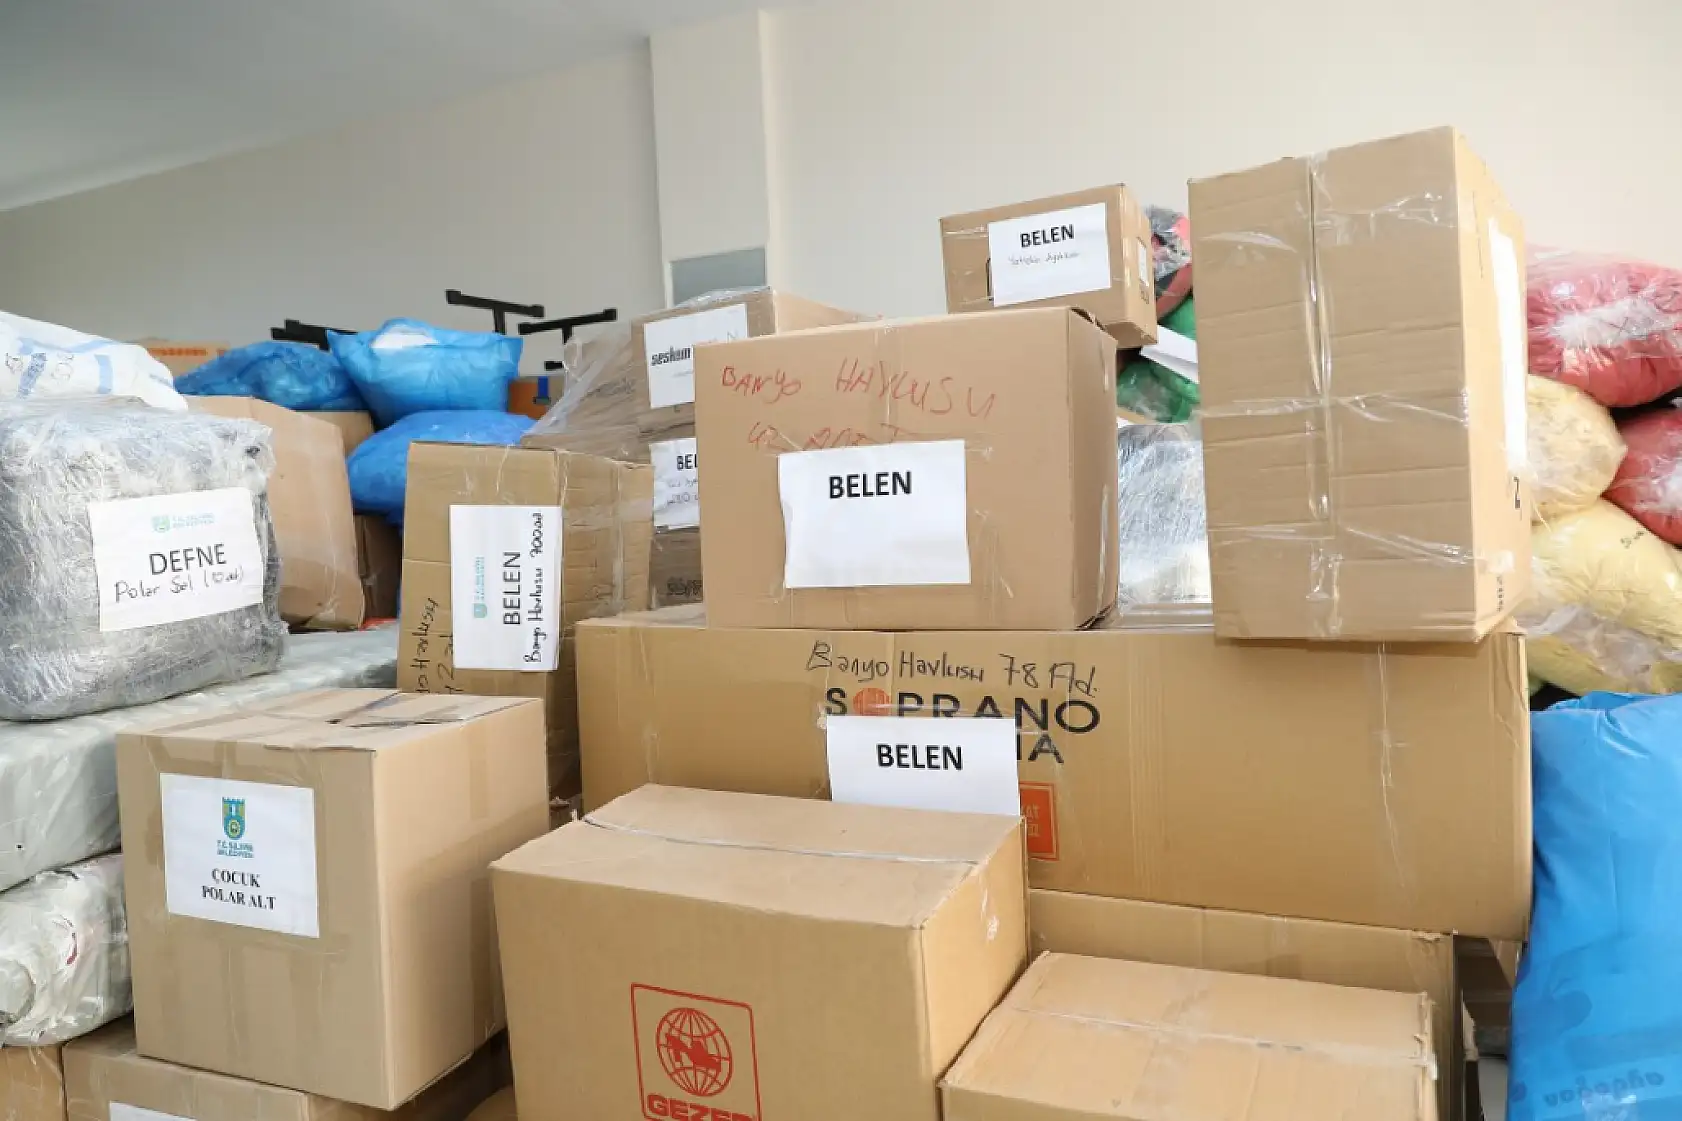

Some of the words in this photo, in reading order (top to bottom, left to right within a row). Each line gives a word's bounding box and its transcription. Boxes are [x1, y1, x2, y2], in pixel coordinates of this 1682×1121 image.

[1019, 224, 1075, 249] BELEN
[828, 470, 913, 500] BELEN
[149, 543, 227, 575] DEFNE
[114, 579, 160, 603] Polar
[502, 551, 521, 625] BELEN
[804, 640, 889, 683] Banyo
[900, 651, 984, 682] Havlusu
[999, 653, 1039, 689] 78
[876, 744, 963, 771] BELEN
[211, 868, 261, 888] ÇOCUK
[202, 885, 246, 906] POLAR
[248, 895, 277, 911] ALT
